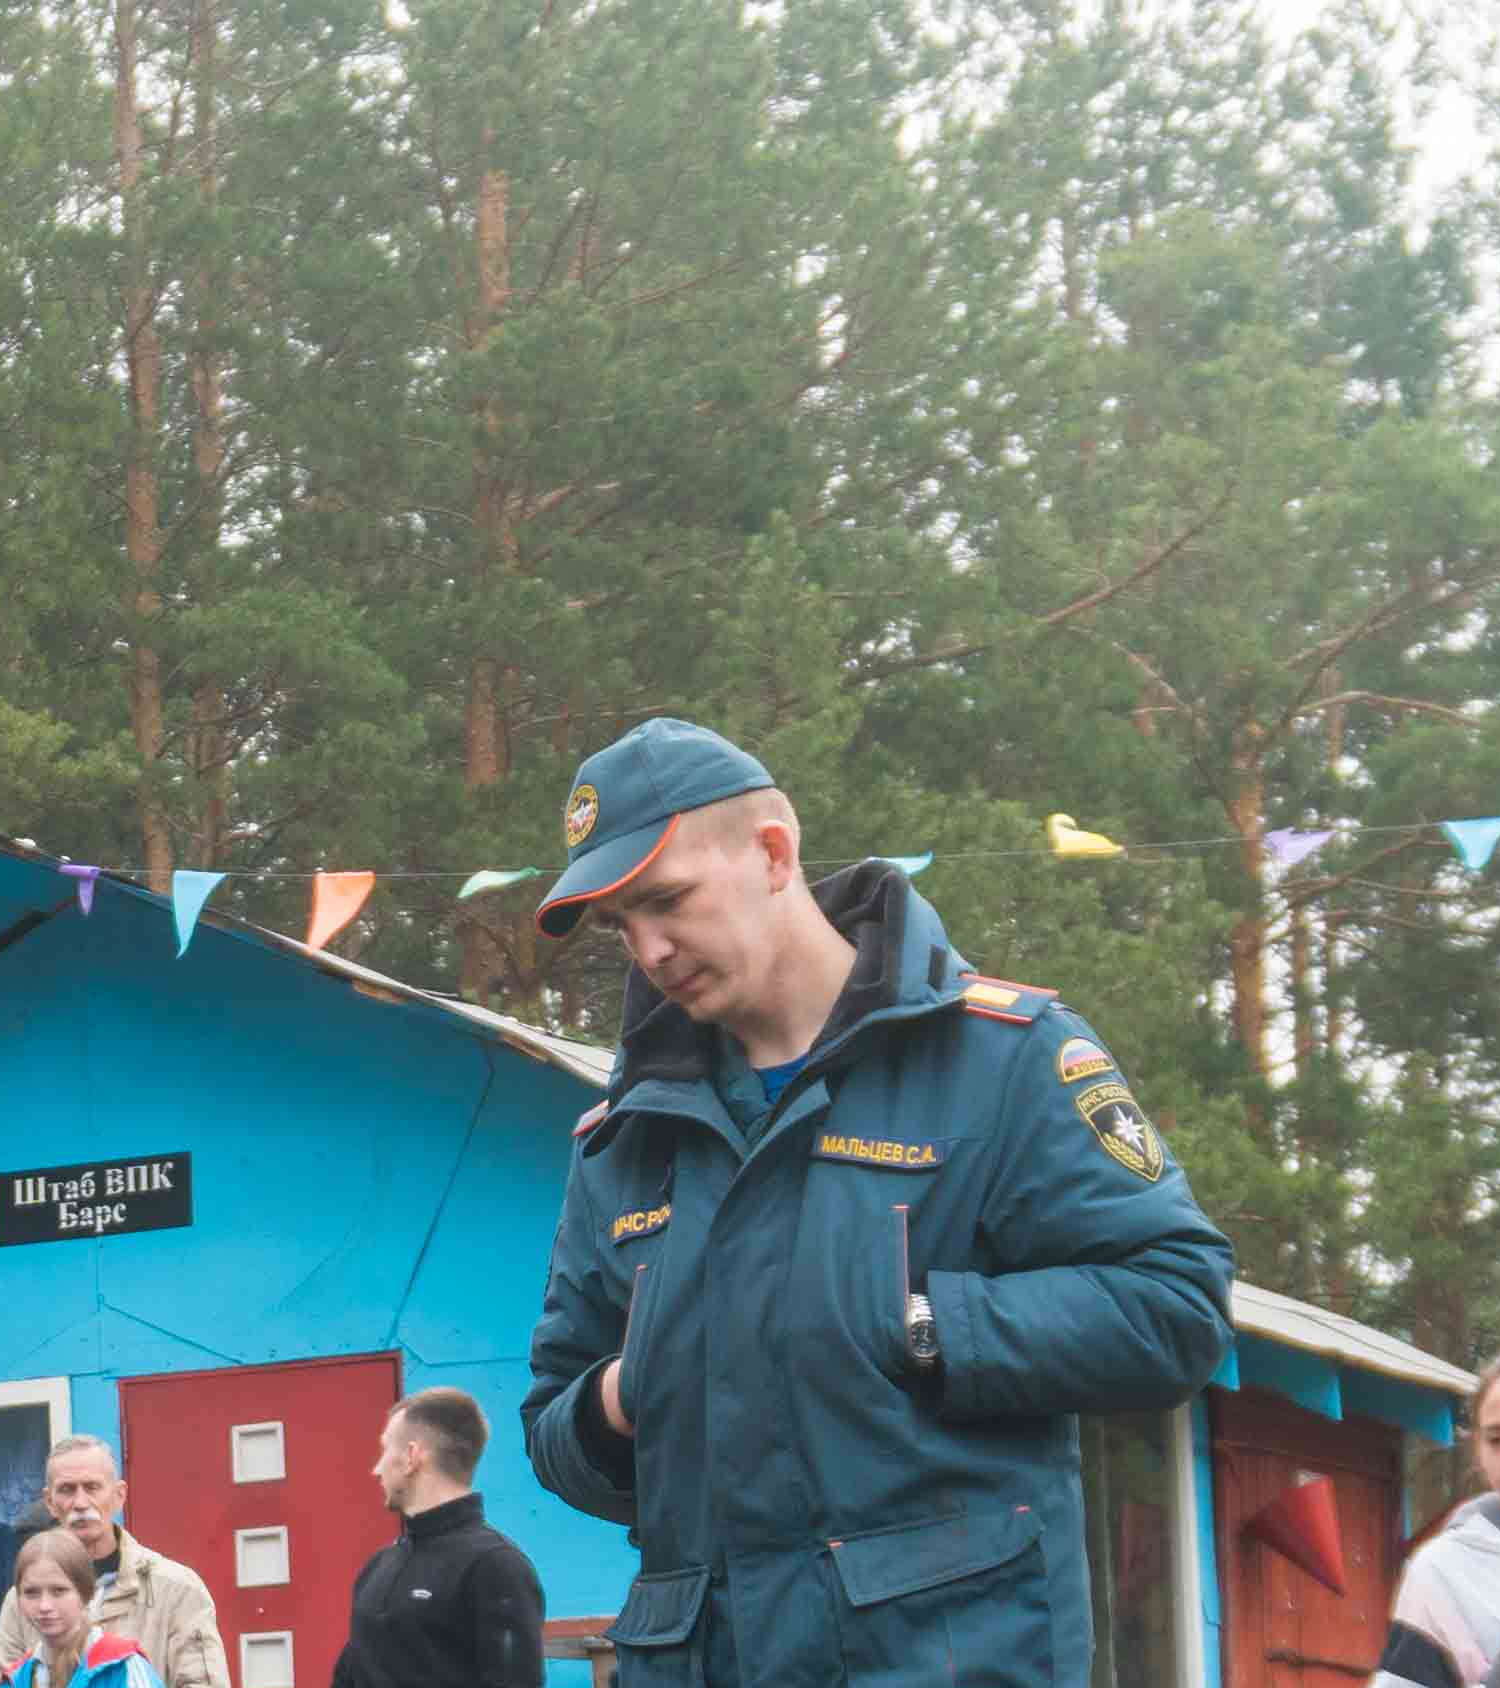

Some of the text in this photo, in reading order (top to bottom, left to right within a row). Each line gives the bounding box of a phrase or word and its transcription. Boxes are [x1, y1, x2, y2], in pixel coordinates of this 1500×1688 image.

[821, 1135, 904, 1163] МАЛЬЦЕВ
[12, 1160, 175, 1206] Штаб ВПК
[58, 1200, 127, 1232] Барс
